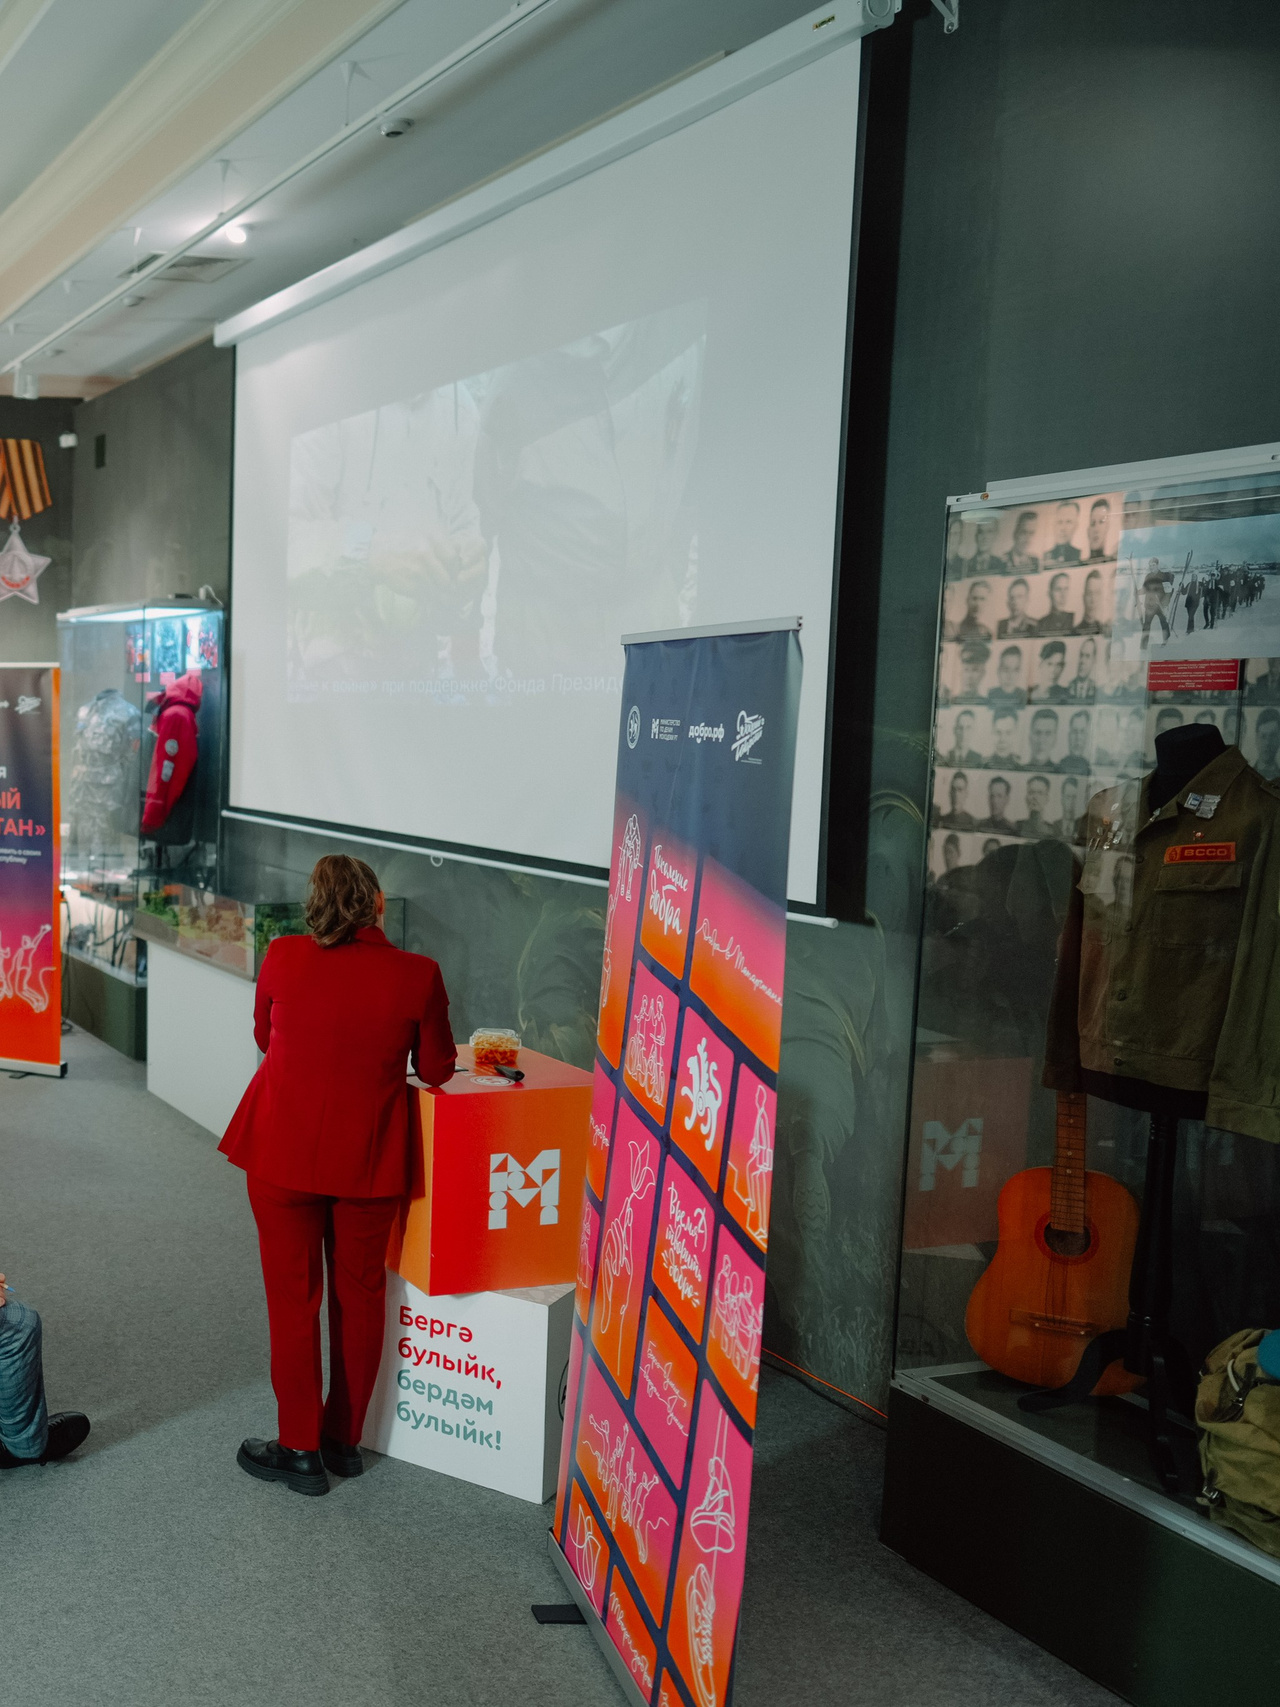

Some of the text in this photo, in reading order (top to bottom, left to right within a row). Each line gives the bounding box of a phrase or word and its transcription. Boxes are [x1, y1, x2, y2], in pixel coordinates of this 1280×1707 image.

[381, 680, 405, 696] при
[409, 679, 488, 696] поддержке
[494, 675, 546, 697] Фонда
[689, 722, 725, 742] добро.рф
[1184, 848, 1227, 857] ВССО
[399, 1305, 473, 1342] Бергә
[398, 1337, 502, 1389] булыйк,
[397, 1369, 493, 1415] бердәм
[396, 1401, 501, 1450] булыйк!
